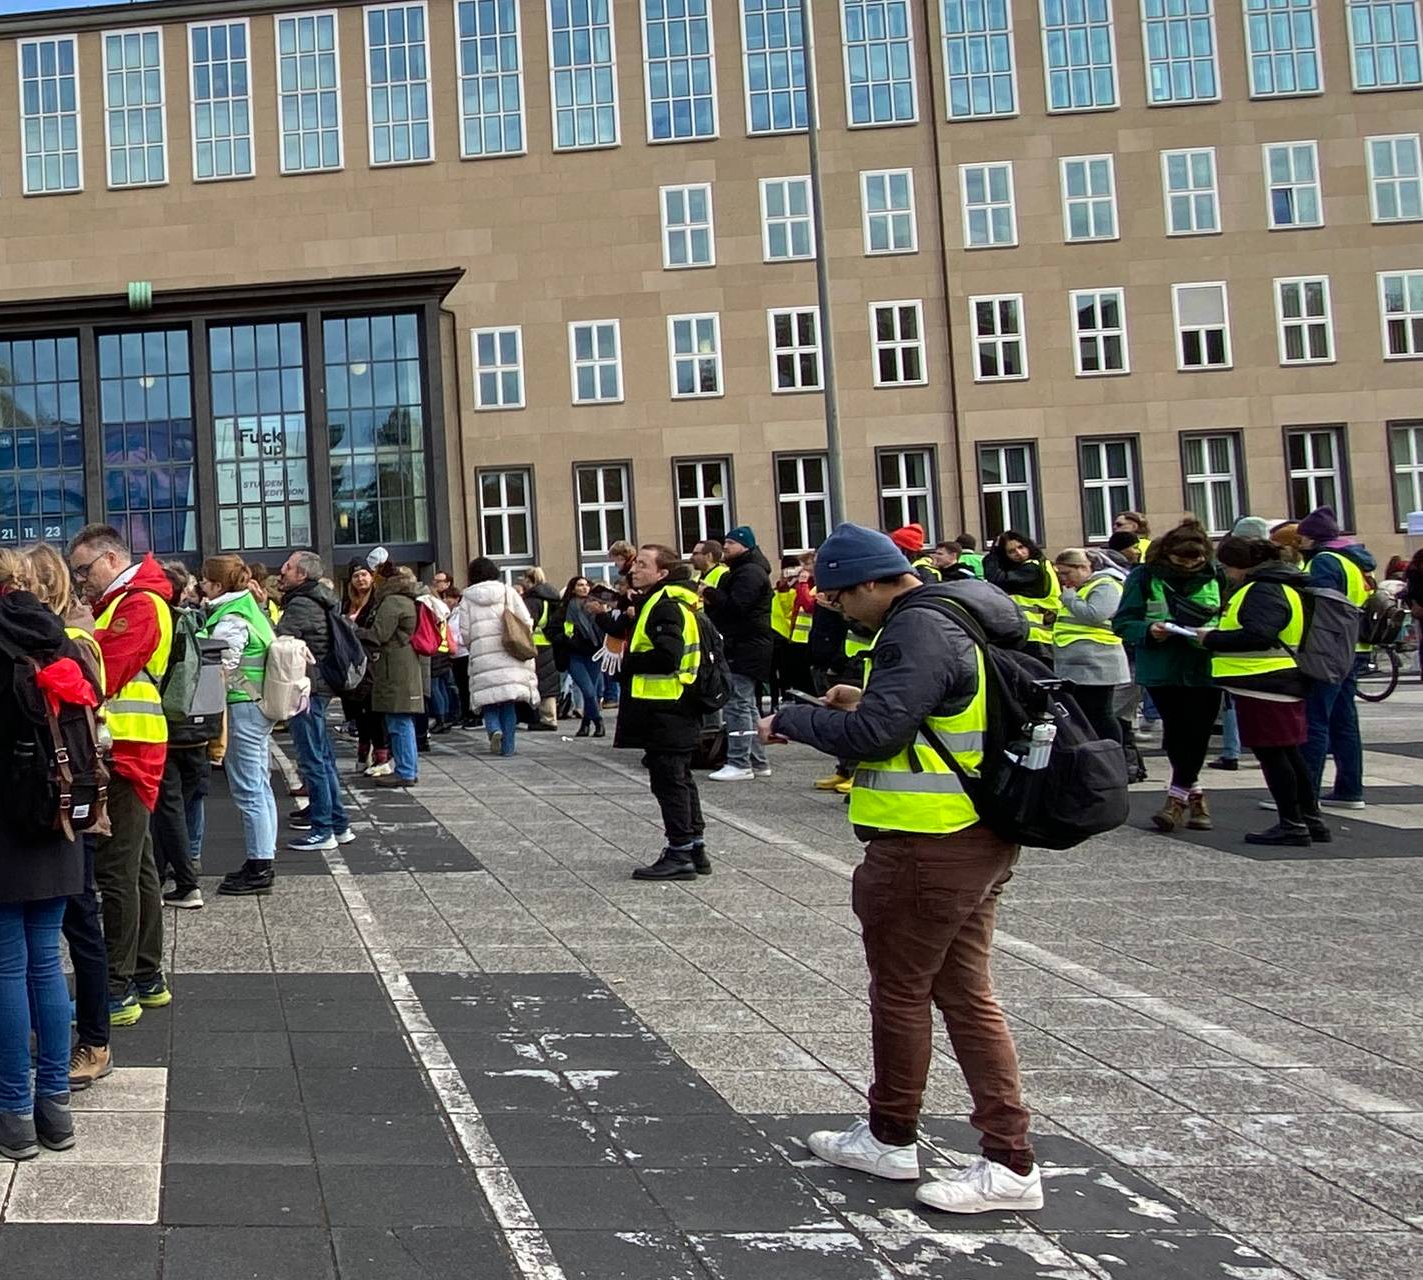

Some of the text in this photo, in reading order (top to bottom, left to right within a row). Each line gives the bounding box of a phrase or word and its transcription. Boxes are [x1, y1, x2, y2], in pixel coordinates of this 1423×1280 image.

[239, 427, 284, 456] Fuck
[264, 445, 283, 464] up
[243, 479, 294, 489] STUDENT
[1, 528, 17, 539] 21.
[45, 526, 61, 538] 23
